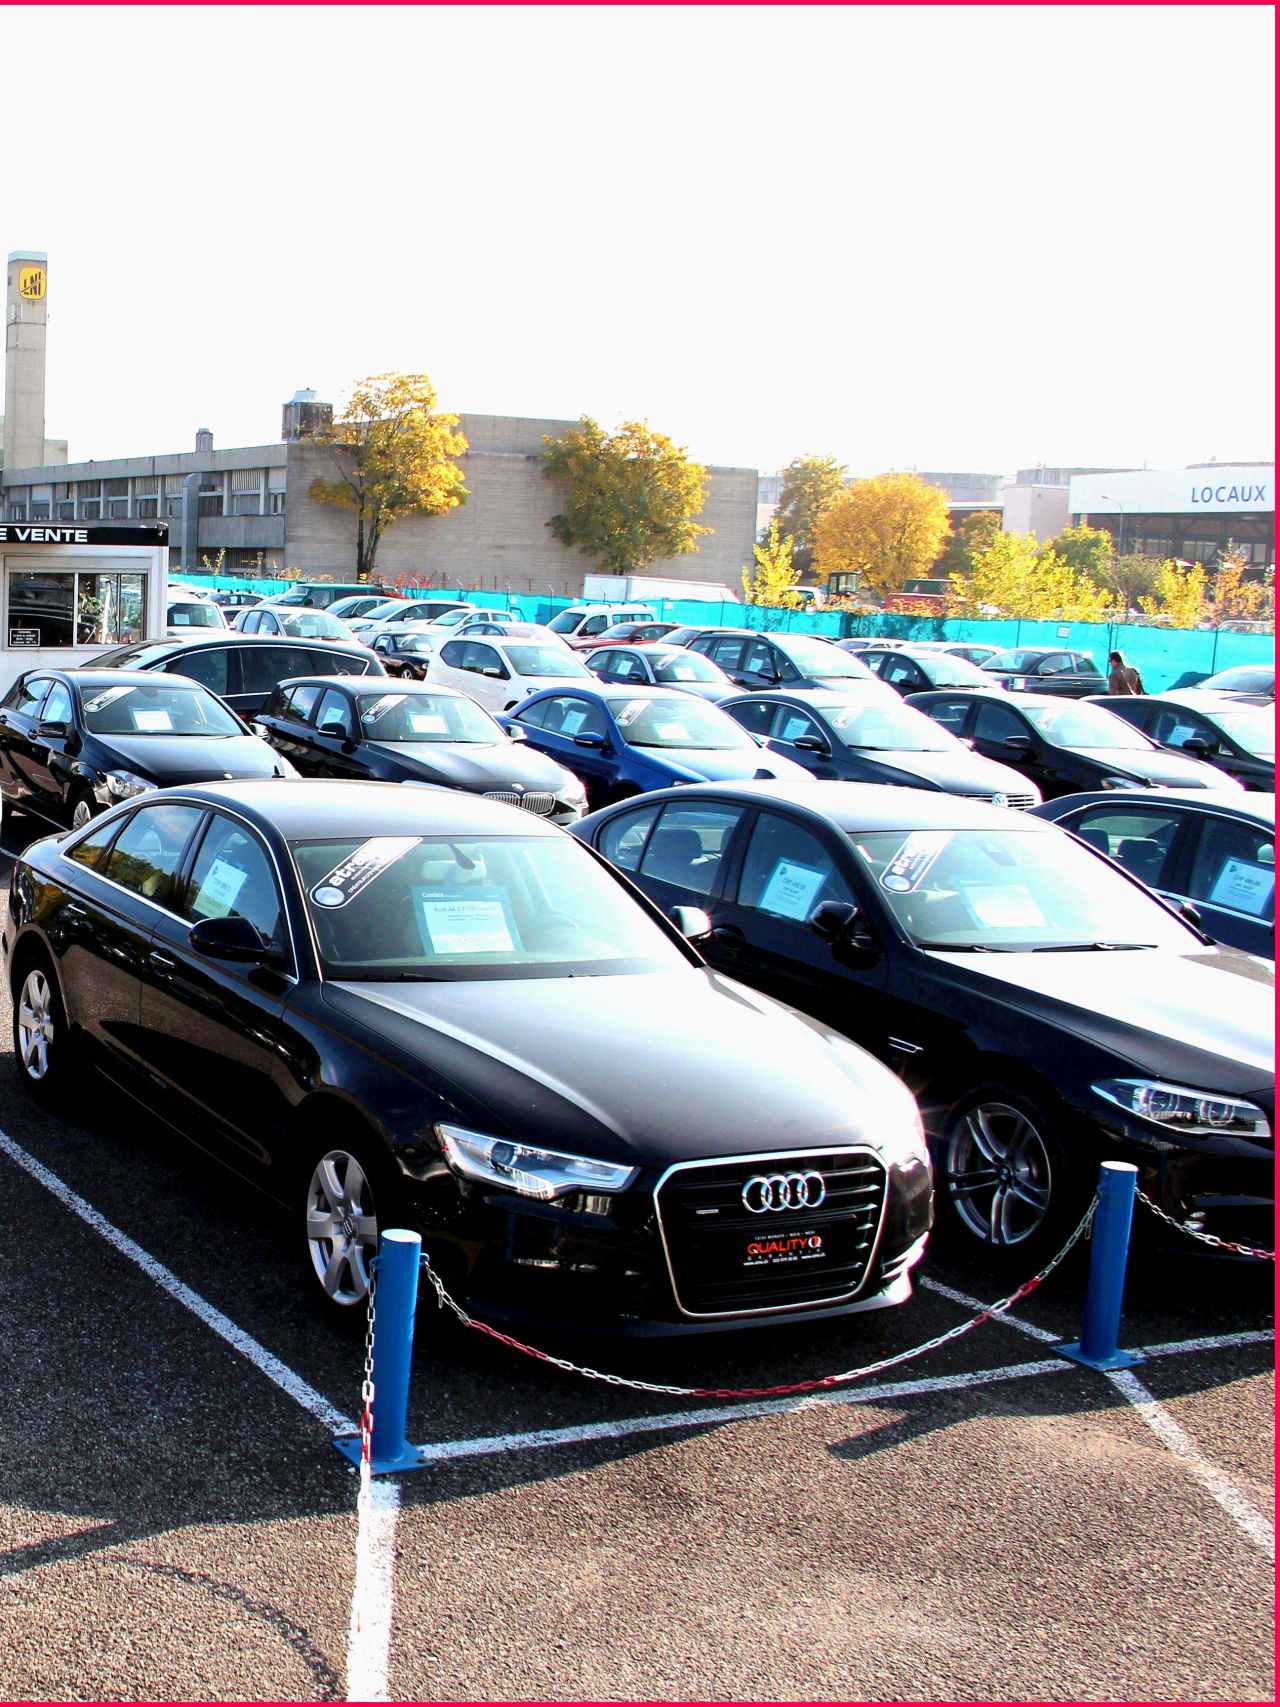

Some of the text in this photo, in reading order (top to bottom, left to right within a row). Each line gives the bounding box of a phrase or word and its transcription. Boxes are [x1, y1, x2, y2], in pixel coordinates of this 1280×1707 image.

[1191, 485, 1267, 503] LOCAUX
[14, 528, 88, 543] VENTE
[747, 1238, 808, 1255] QUALITY
